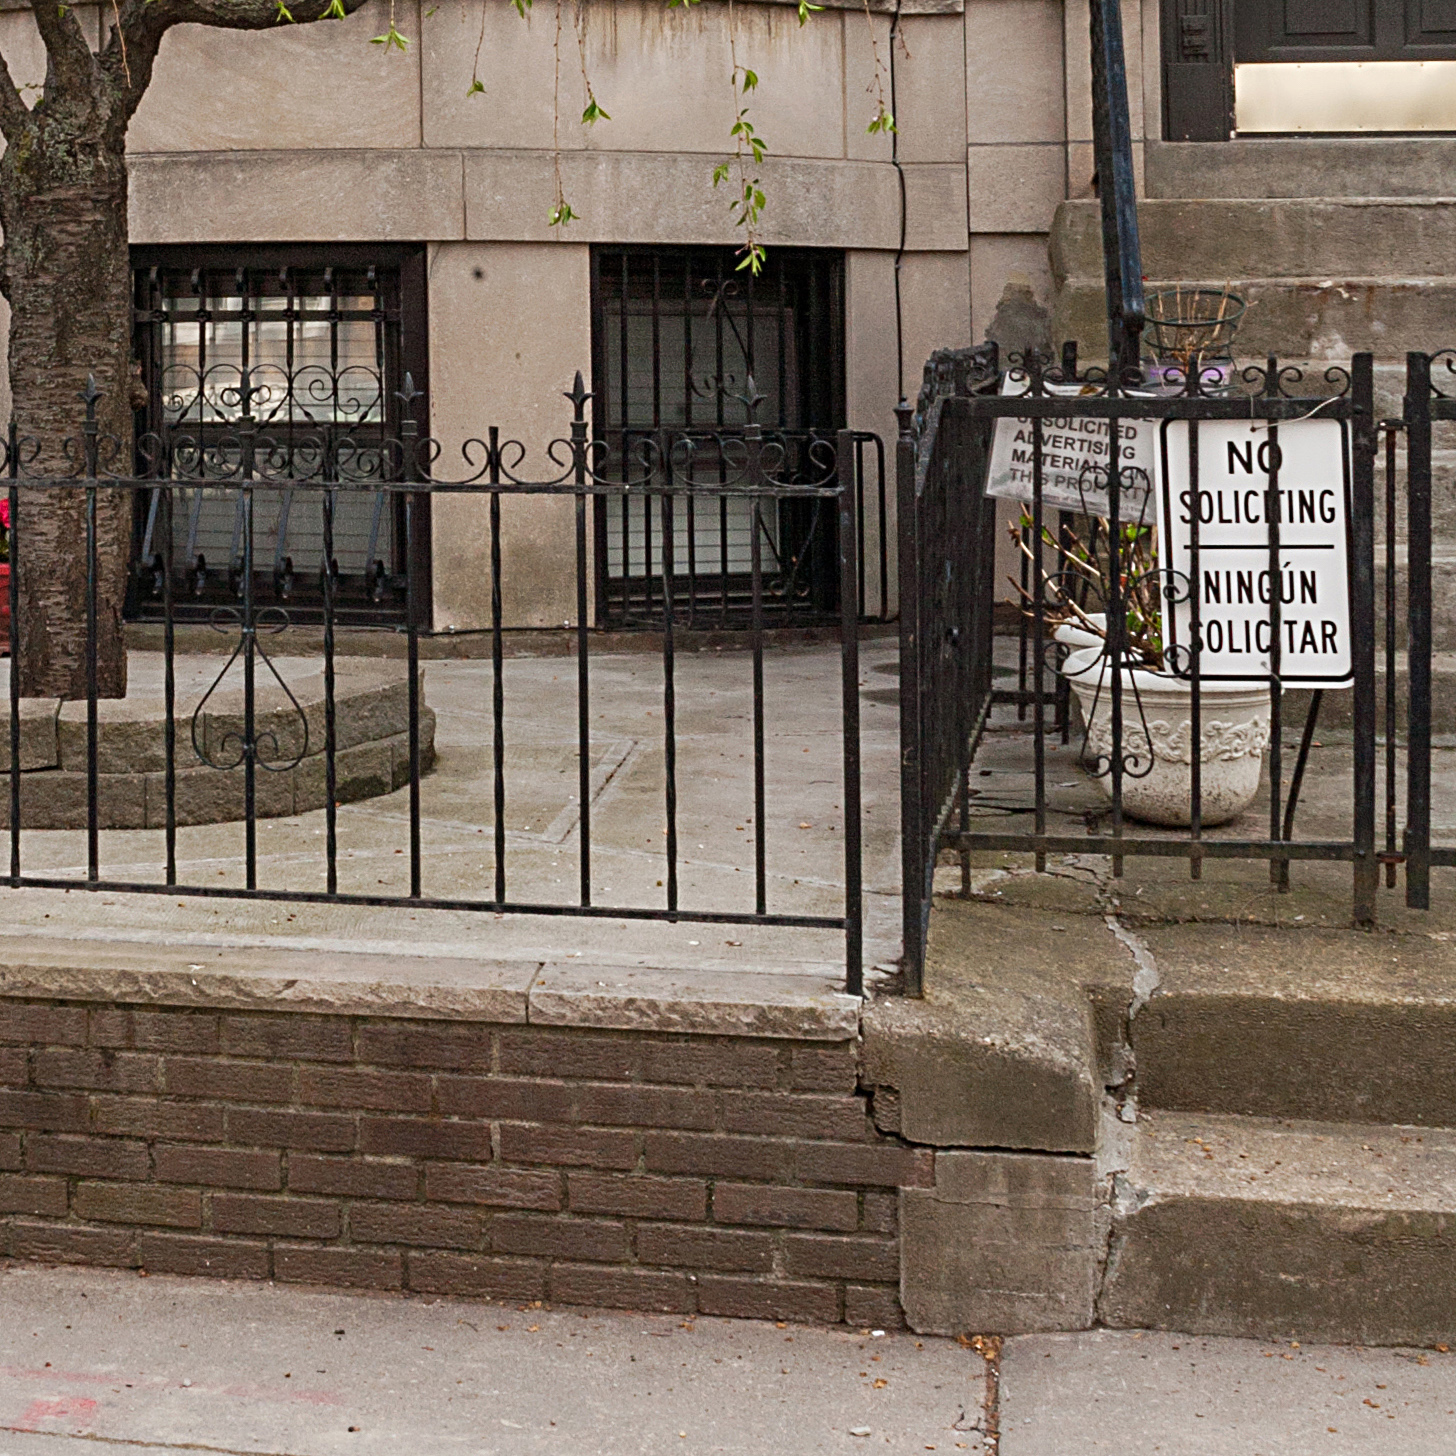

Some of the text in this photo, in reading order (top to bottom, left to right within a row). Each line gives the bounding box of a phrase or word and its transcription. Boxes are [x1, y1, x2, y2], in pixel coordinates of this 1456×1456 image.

[1227, 440, 1283, 475] NO
[1009, 467, 1050, 486] THS
[1204, 560, 1318, 605] NINGÚN
[1188, 619, 1339, 655] SOLICTAR
